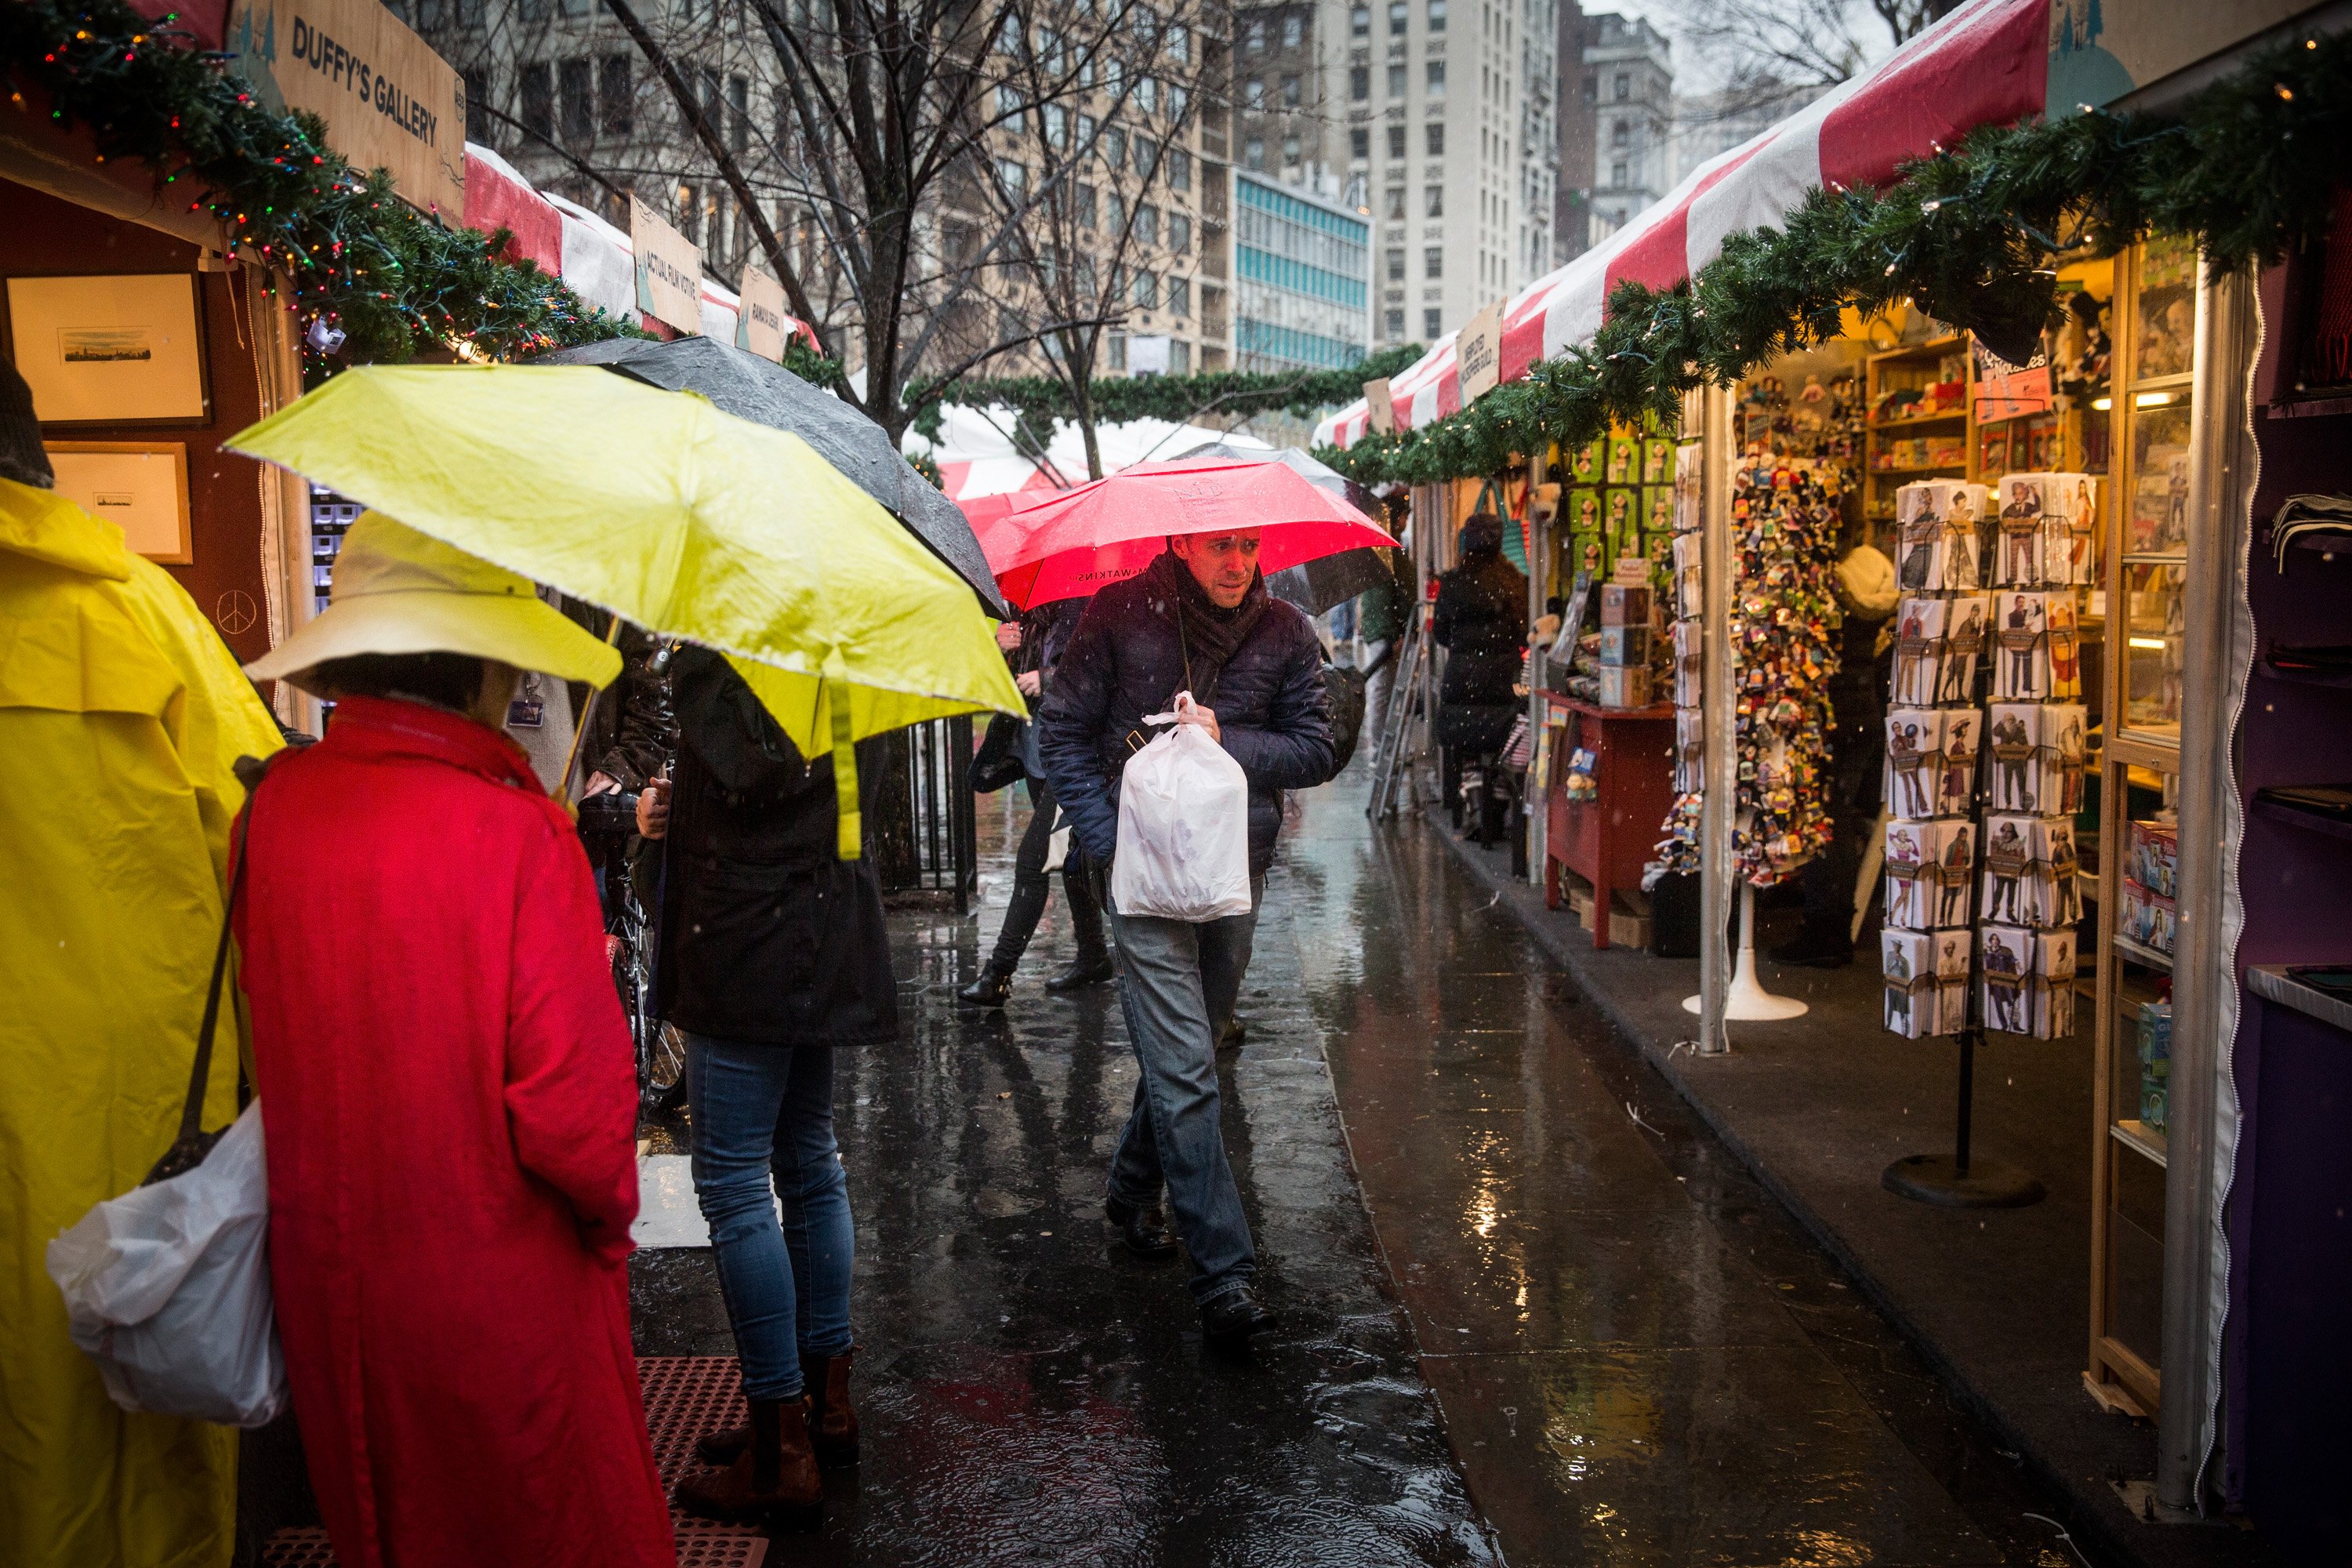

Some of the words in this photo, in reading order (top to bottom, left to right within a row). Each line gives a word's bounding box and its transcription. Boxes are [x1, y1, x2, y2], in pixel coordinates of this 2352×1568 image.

[292, 15, 371, 103] DUFFY'S
[374, 74, 437, 148] GALLERY
[647, 249, 668, 282] ACTUAL
